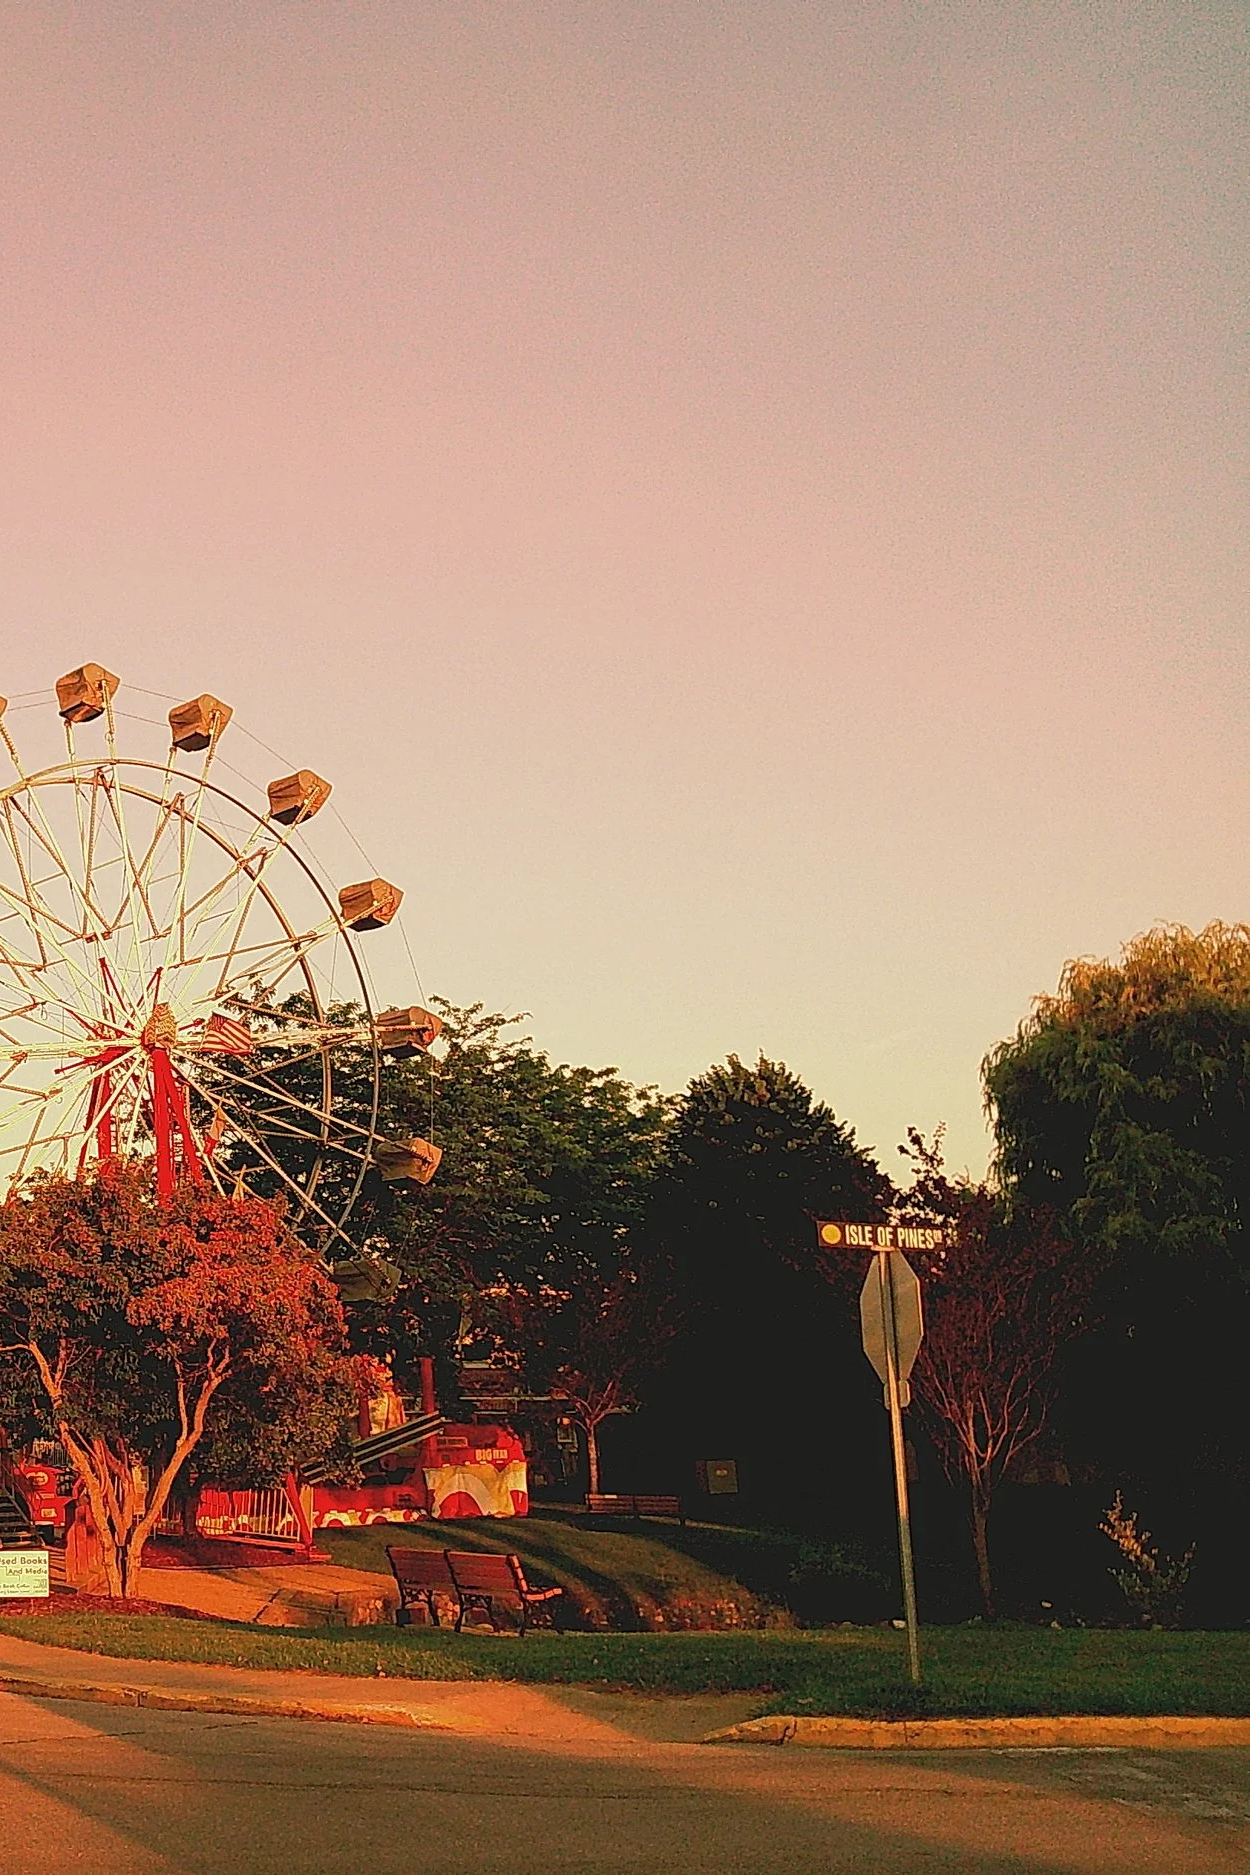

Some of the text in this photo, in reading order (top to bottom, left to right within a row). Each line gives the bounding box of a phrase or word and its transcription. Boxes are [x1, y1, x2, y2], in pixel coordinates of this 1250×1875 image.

[845, 1225, 873, 1246] ISLE
[877, 1226, 894, 1246] OF
[897, 1227, 935, 1249] PINES
[20, 1556, 48, 1565] Books
